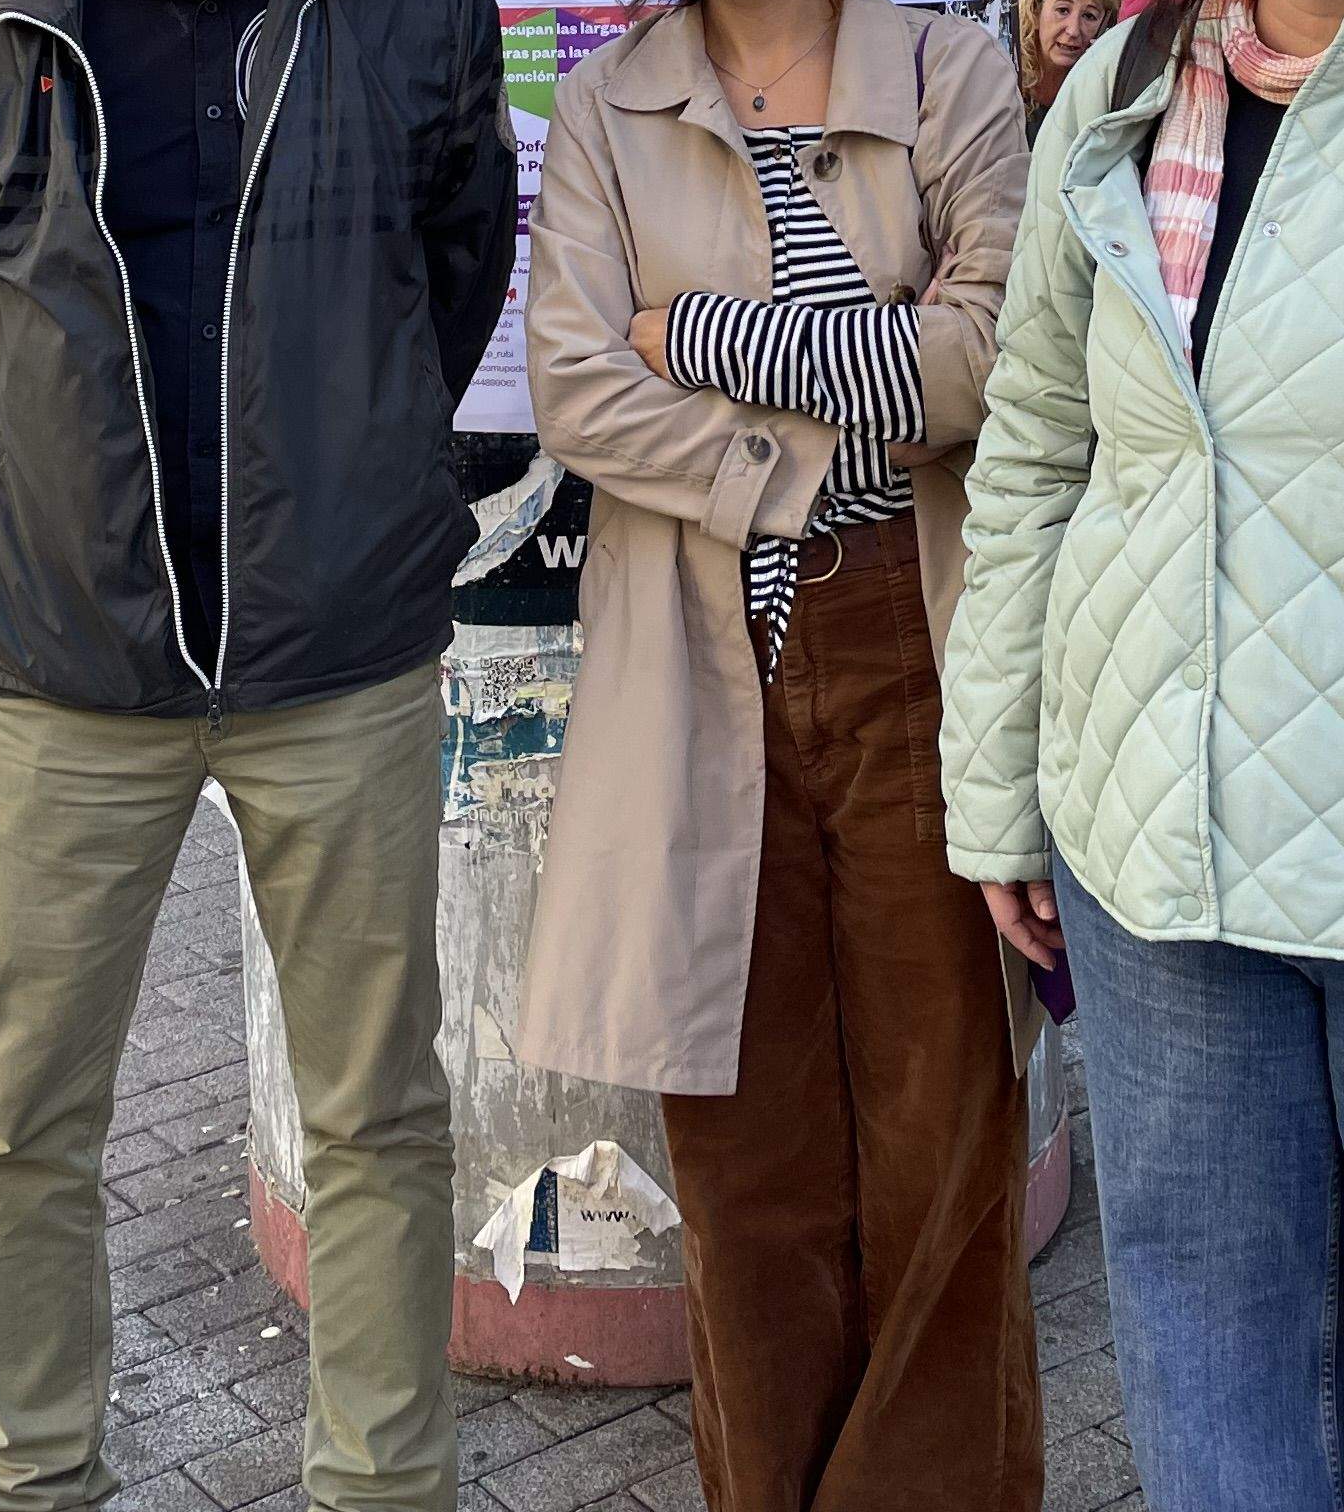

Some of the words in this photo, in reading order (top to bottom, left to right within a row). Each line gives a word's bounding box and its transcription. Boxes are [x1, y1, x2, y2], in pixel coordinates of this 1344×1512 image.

[556, 22, 578, 35] las
[580, 21, 625, 37] largas
[532, 48, 567, 61] para
